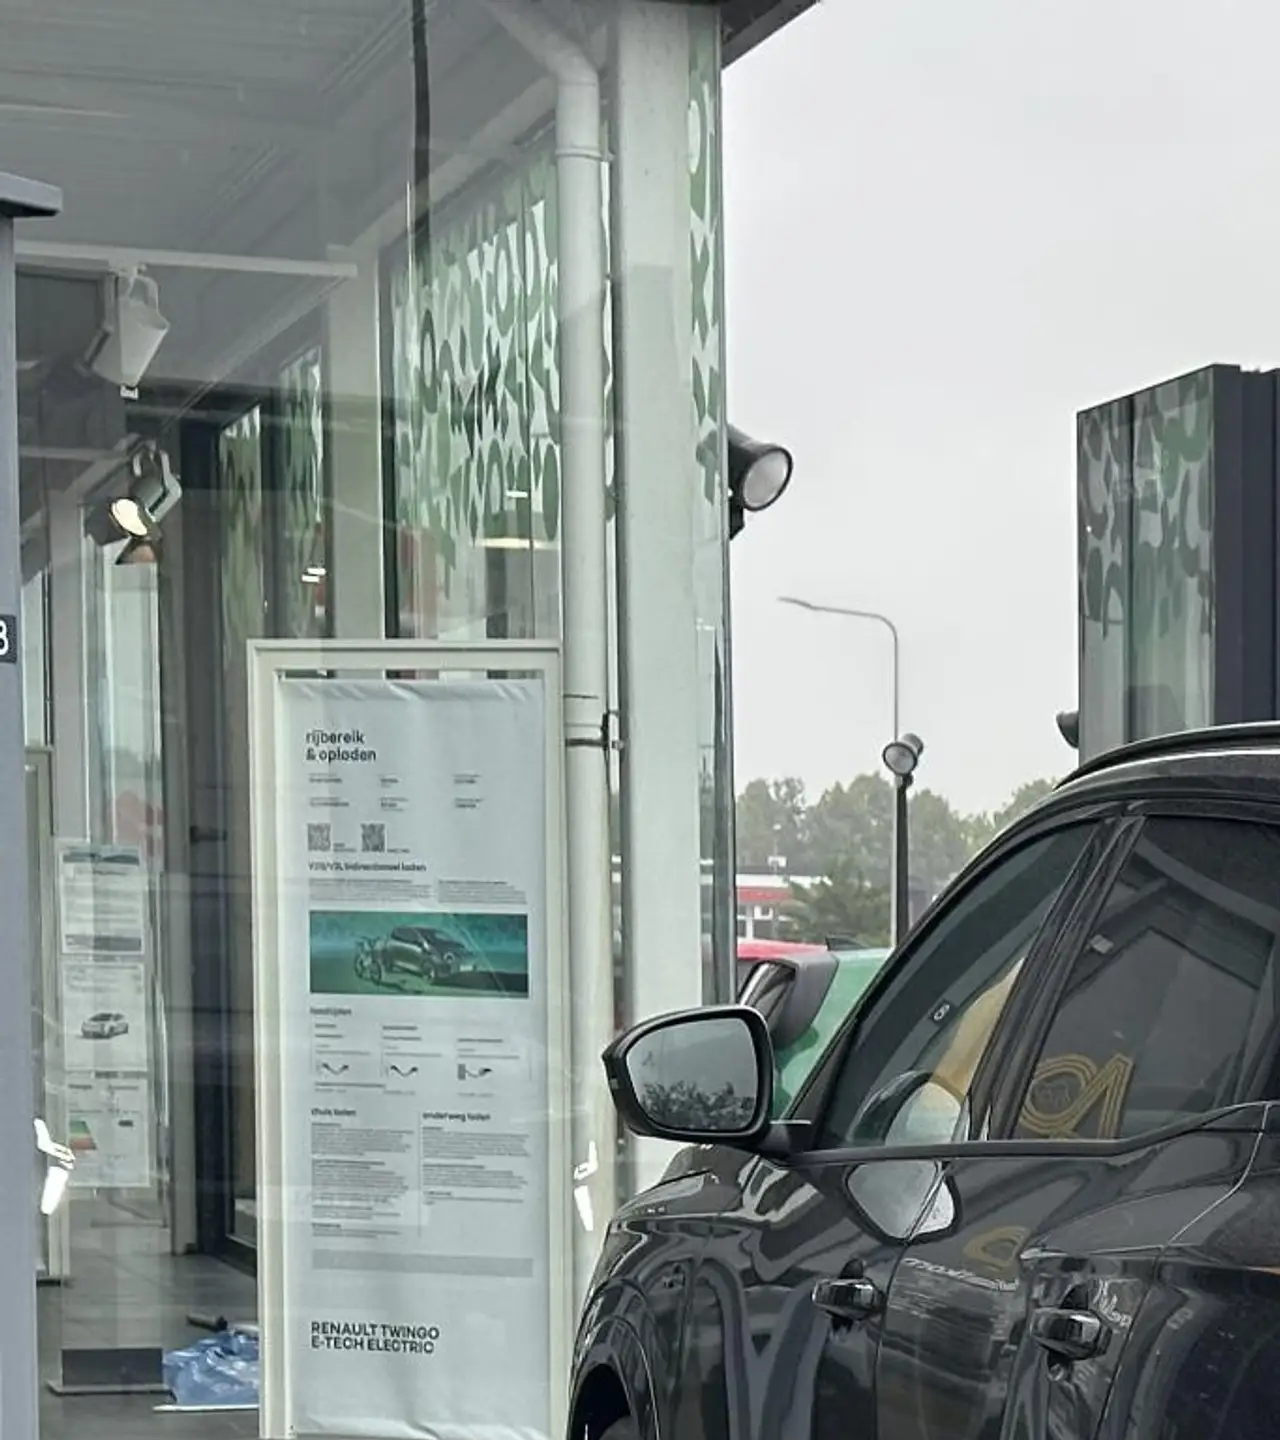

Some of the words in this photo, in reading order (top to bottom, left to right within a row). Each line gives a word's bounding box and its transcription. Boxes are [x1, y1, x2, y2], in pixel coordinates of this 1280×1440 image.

[305, 729, 365, 747] rijbereik
[305, 747, 317, 761] &
[311, 1321, 378, 1336] RENAULT
[380, 1323, 440, 1340] TWINGO
[310, 1335, 364, 1350] E-TECH
[367, 1338, 435, 1354] ELECTRIC
